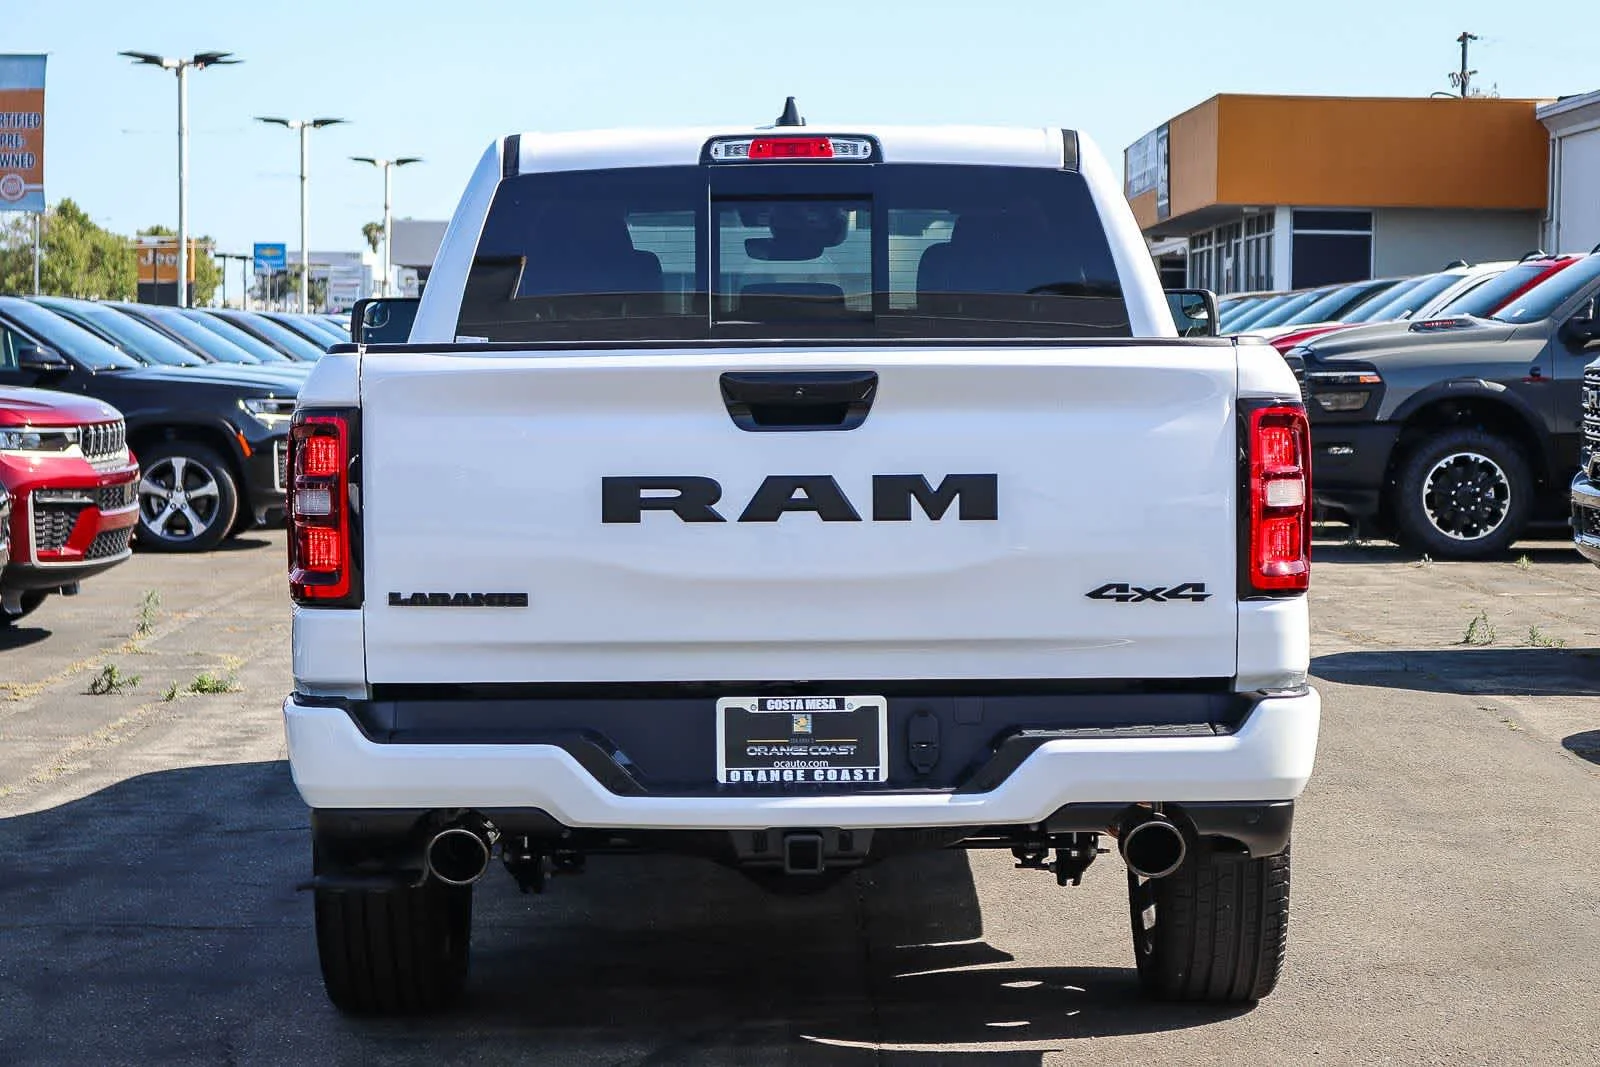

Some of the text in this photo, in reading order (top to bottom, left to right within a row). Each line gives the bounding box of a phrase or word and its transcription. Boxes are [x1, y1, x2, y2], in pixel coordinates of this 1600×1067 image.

[140, 248, 185, 267] Jee
[602, 473, 999, 523] RAM
[388, 592, 528, 607] LARAMIE
[1085, 582, 1212, 603] 4x4
[766, 698, 837, 711] COSTA MESA
[746, 745, 857, 756] ORANGE COAST
[773, 759, 829, 768] ocauto.com
[730, 769, 876, 782] ORANGE COAST
